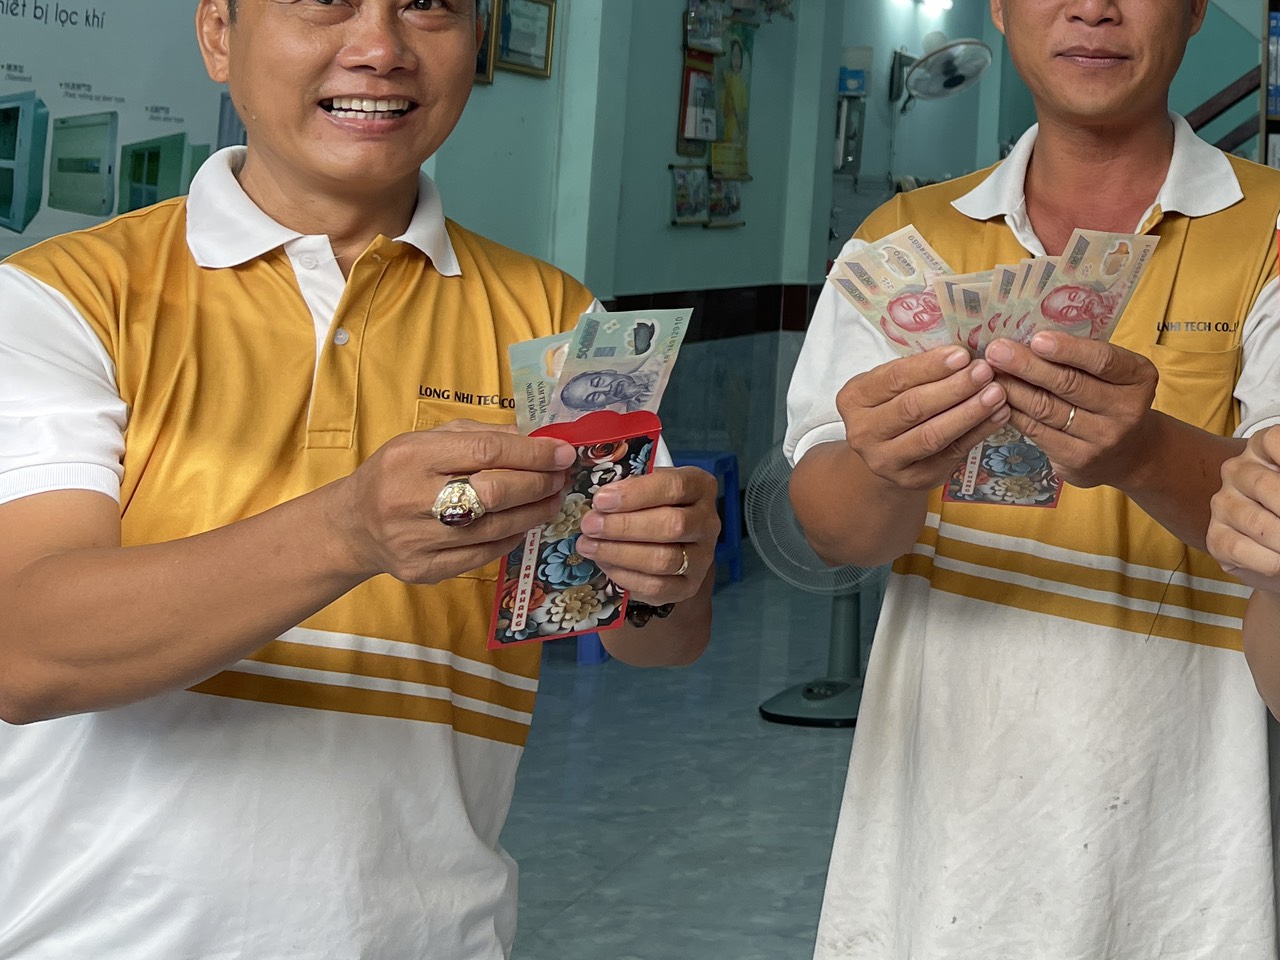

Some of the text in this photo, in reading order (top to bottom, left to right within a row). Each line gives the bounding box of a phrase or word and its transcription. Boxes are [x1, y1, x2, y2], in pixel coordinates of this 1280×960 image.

[54, 2, 79, 28] lọc
[85, 8, 106, 30] khí
[1184, 321, 1212, 332] TECH
[419, 384, 451, 400] LONG
[454, 390, 473, 405] NHI
[515, 589, 527, 628] KHANG
